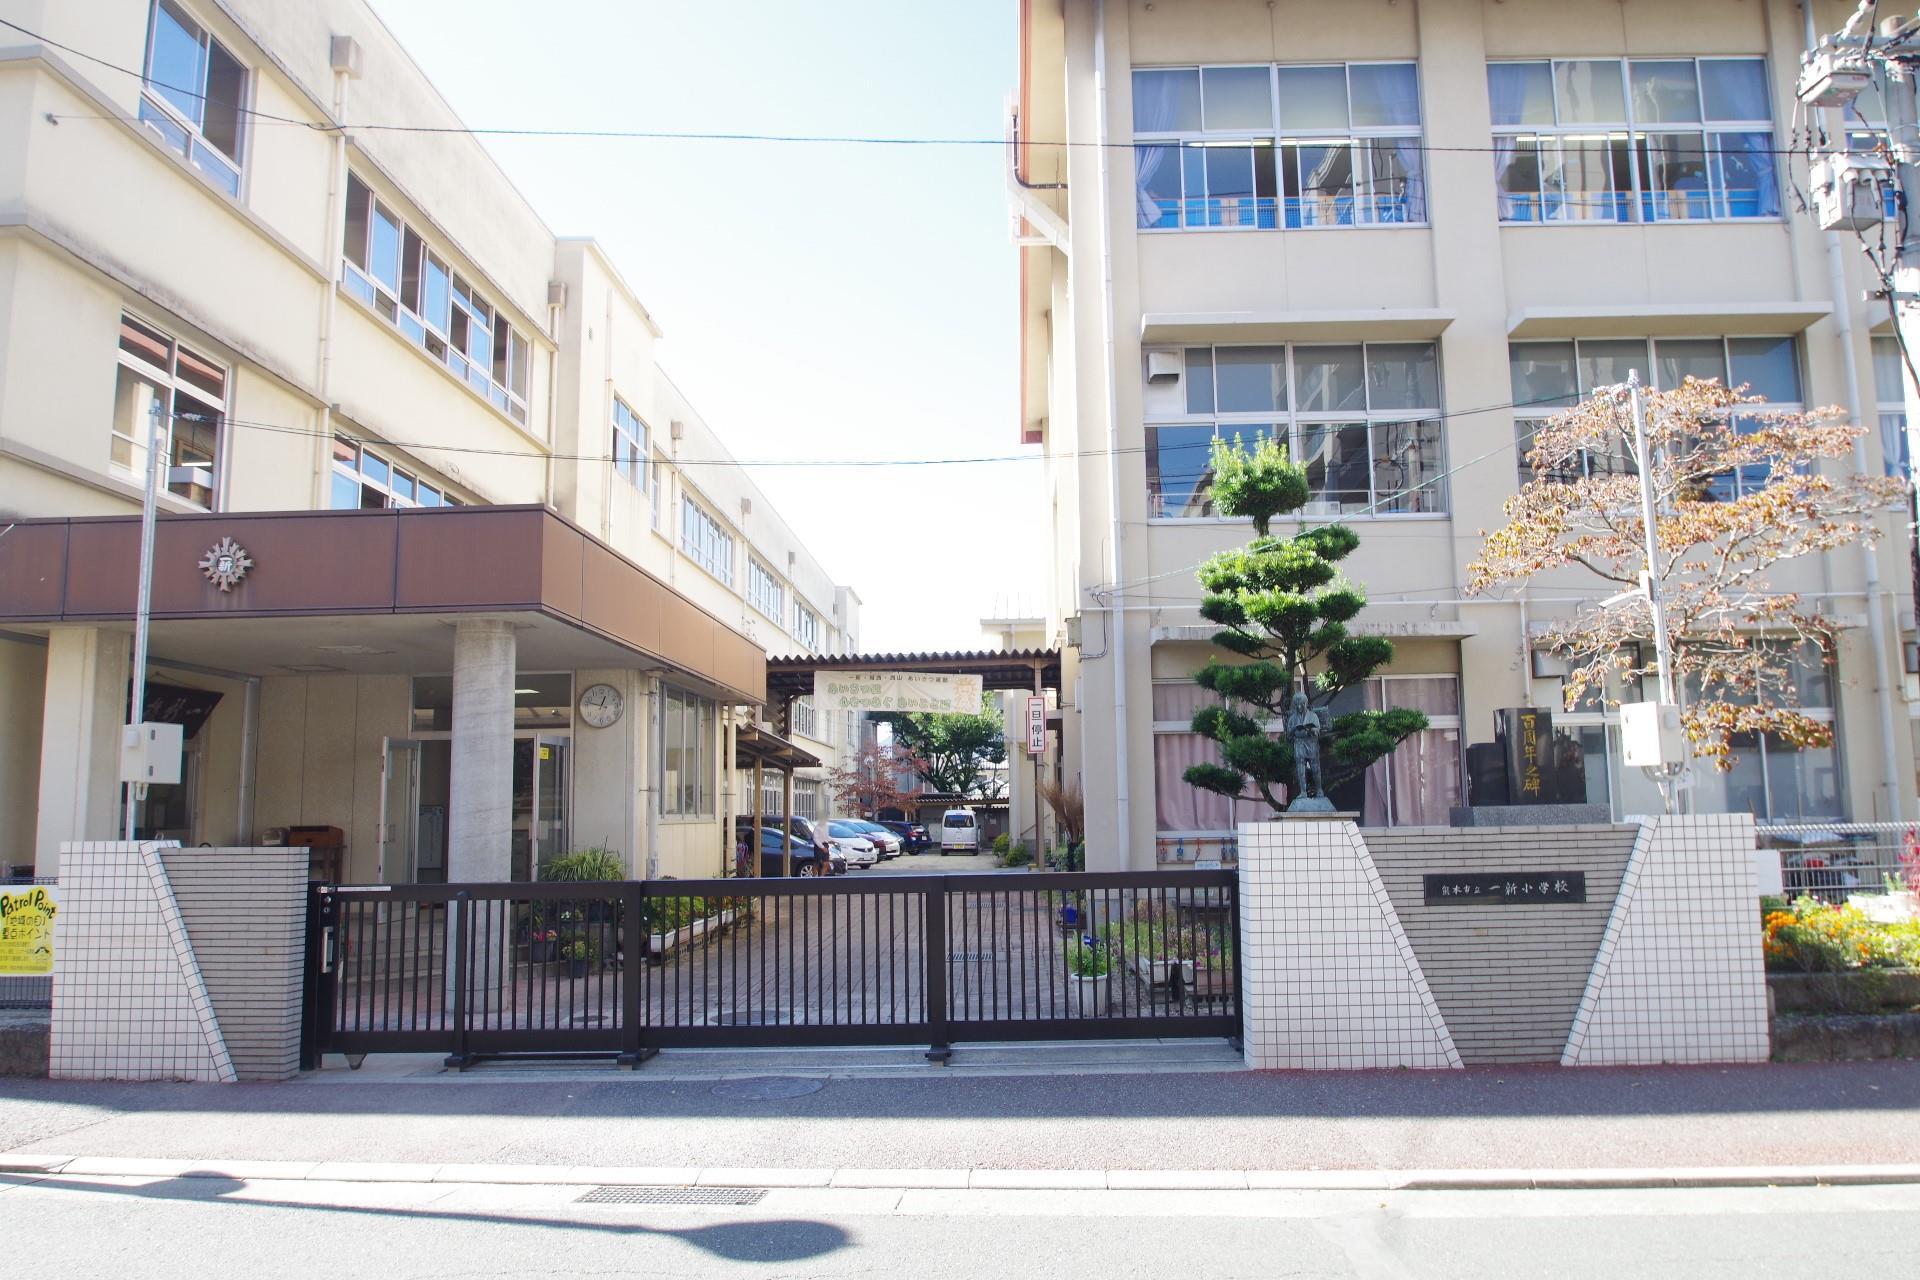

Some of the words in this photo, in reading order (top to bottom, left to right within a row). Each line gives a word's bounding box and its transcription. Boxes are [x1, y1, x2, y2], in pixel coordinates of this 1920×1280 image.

[1031, 703, 1042, 747] 一旦停止
[0, 892, 33, 918] Patrol
[34, 889, 56, 920] Point
